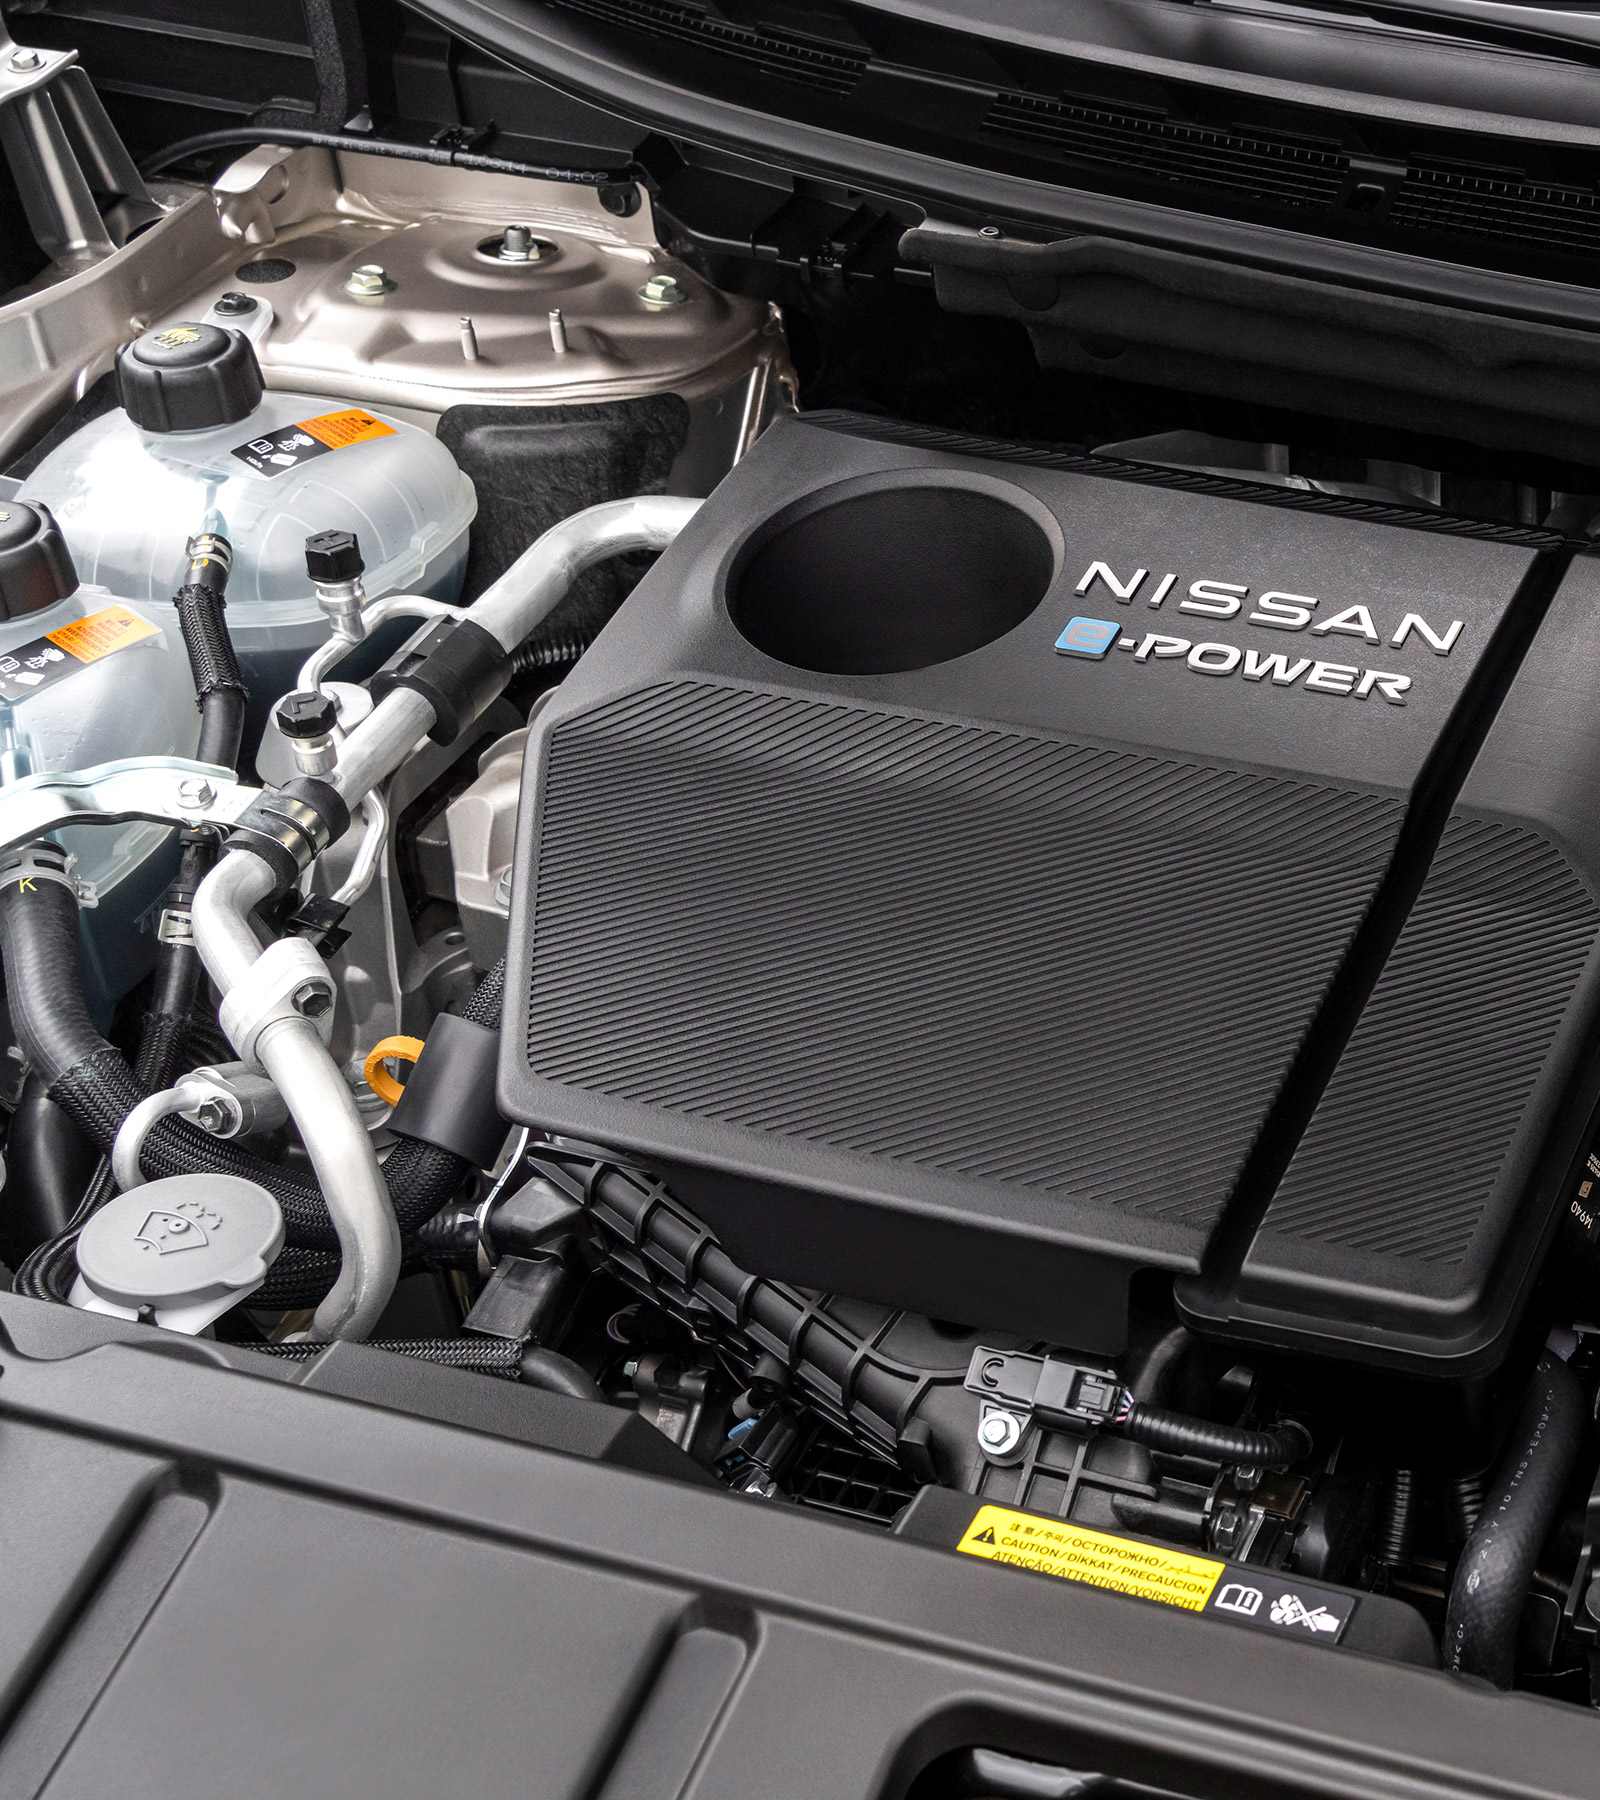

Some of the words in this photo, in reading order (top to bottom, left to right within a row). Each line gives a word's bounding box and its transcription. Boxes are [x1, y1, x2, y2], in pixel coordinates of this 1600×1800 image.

[1073, 560, 1466, 657] NISSAN
[1055, 616, 1414, 706] e-POWER
[19, 877, 38, 894] K
[1570, 1200, 1594, 1230] 14940
[1510, 1461, 1529, 1488] TNS
